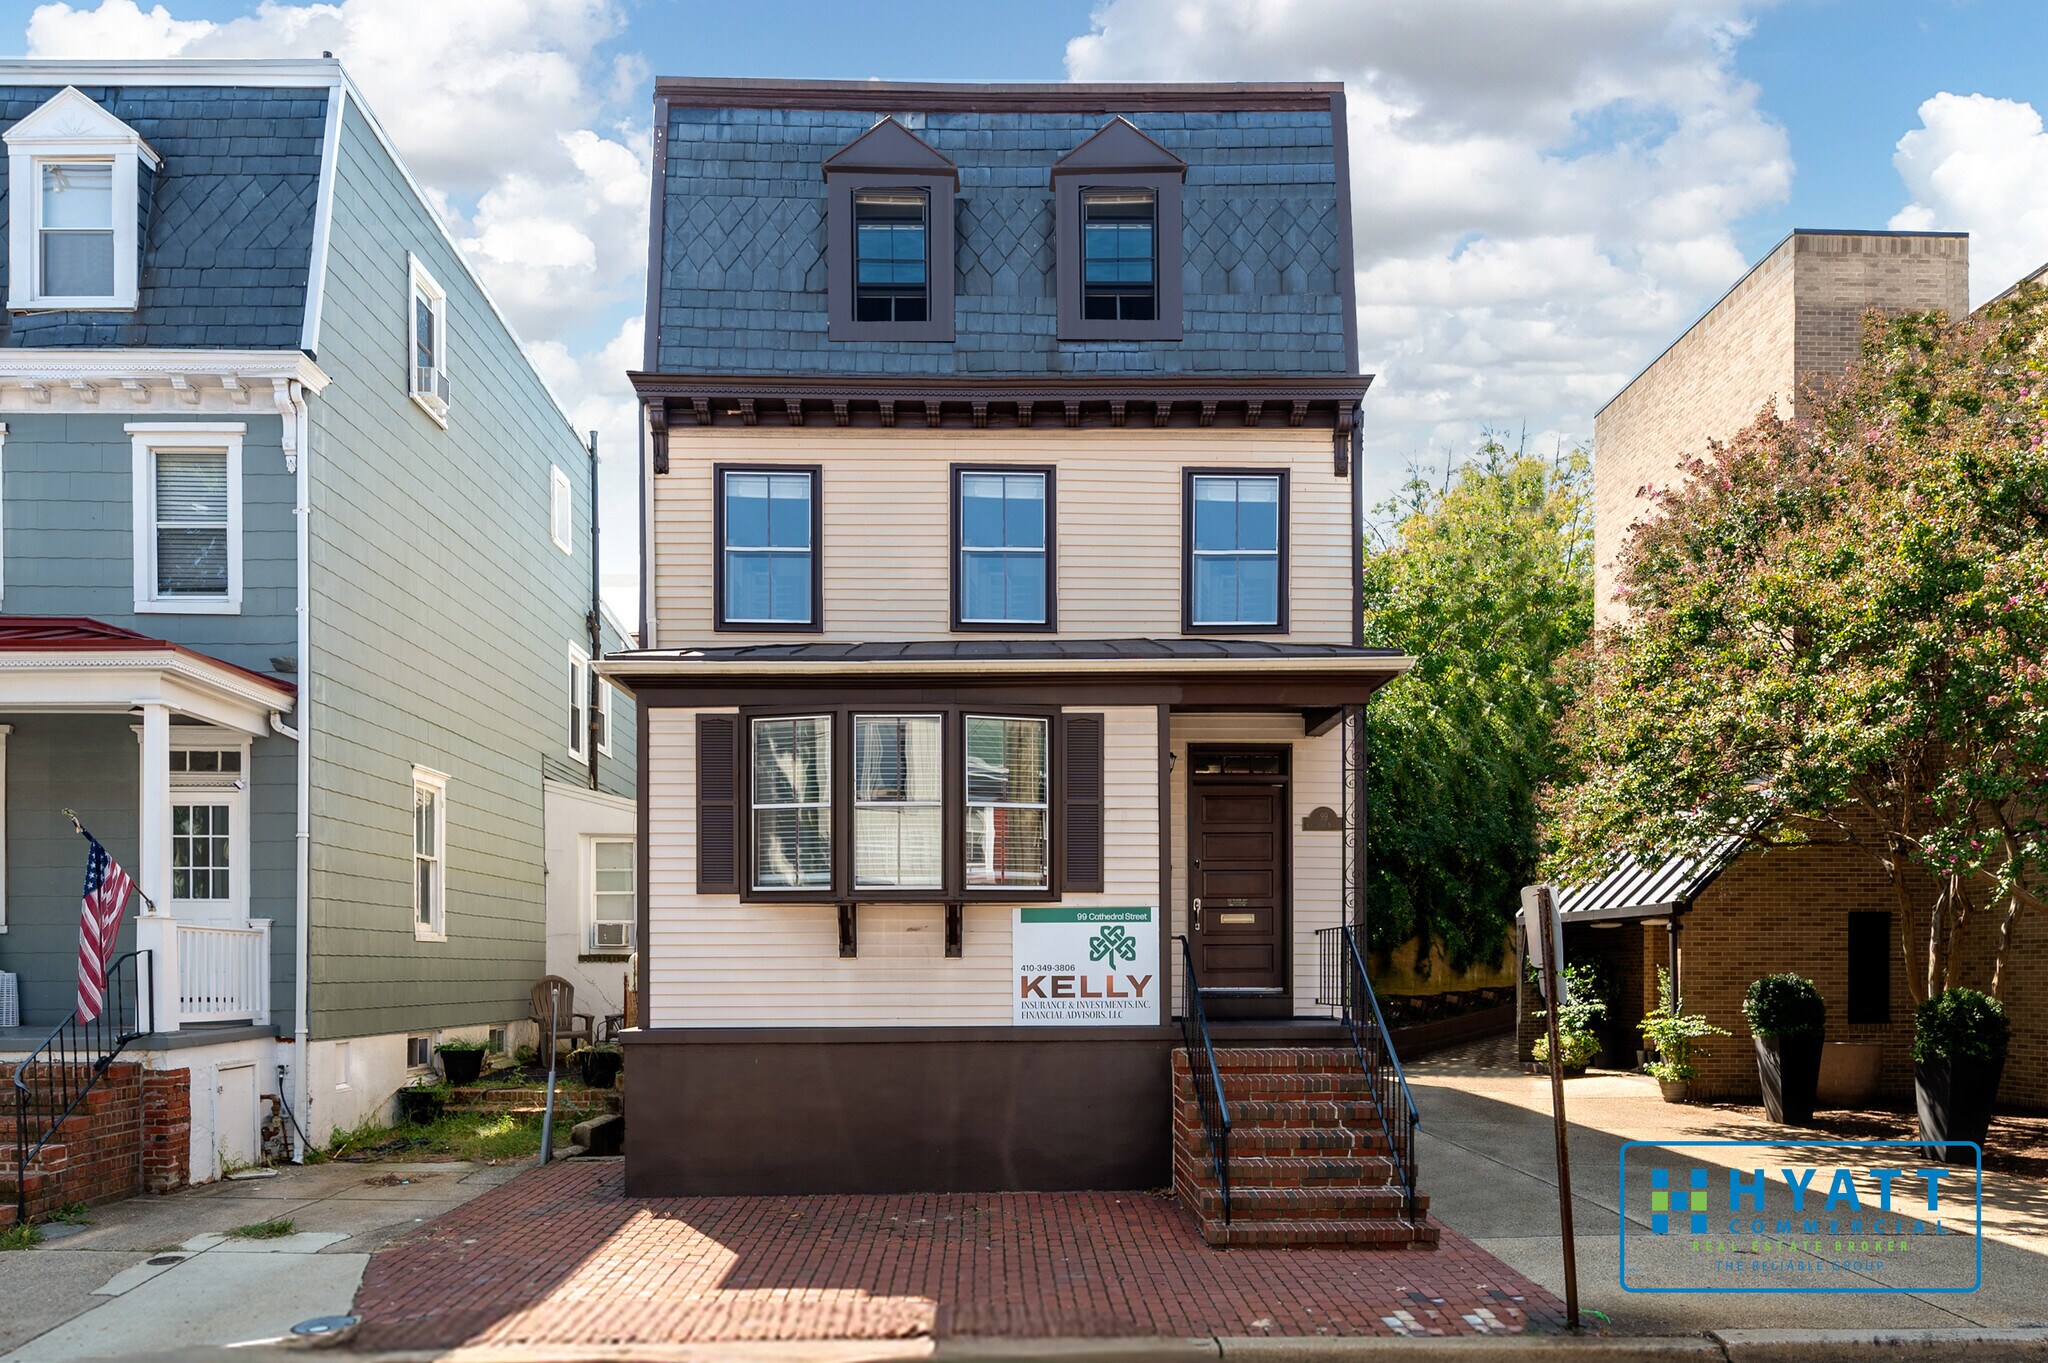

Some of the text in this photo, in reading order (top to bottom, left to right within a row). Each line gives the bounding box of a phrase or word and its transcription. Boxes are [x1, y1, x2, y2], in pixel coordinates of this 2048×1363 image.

[1077, 912, 1147, 920] 99 Cathedral Street
[1021, 975, 1152, 998] KELLY
[1021, 1001, 1067, 1009] INSURANCE
[1021, 1011, 1064, 1019] FINANCIAL
[1108, 1010, 1124, 1019] LLC
